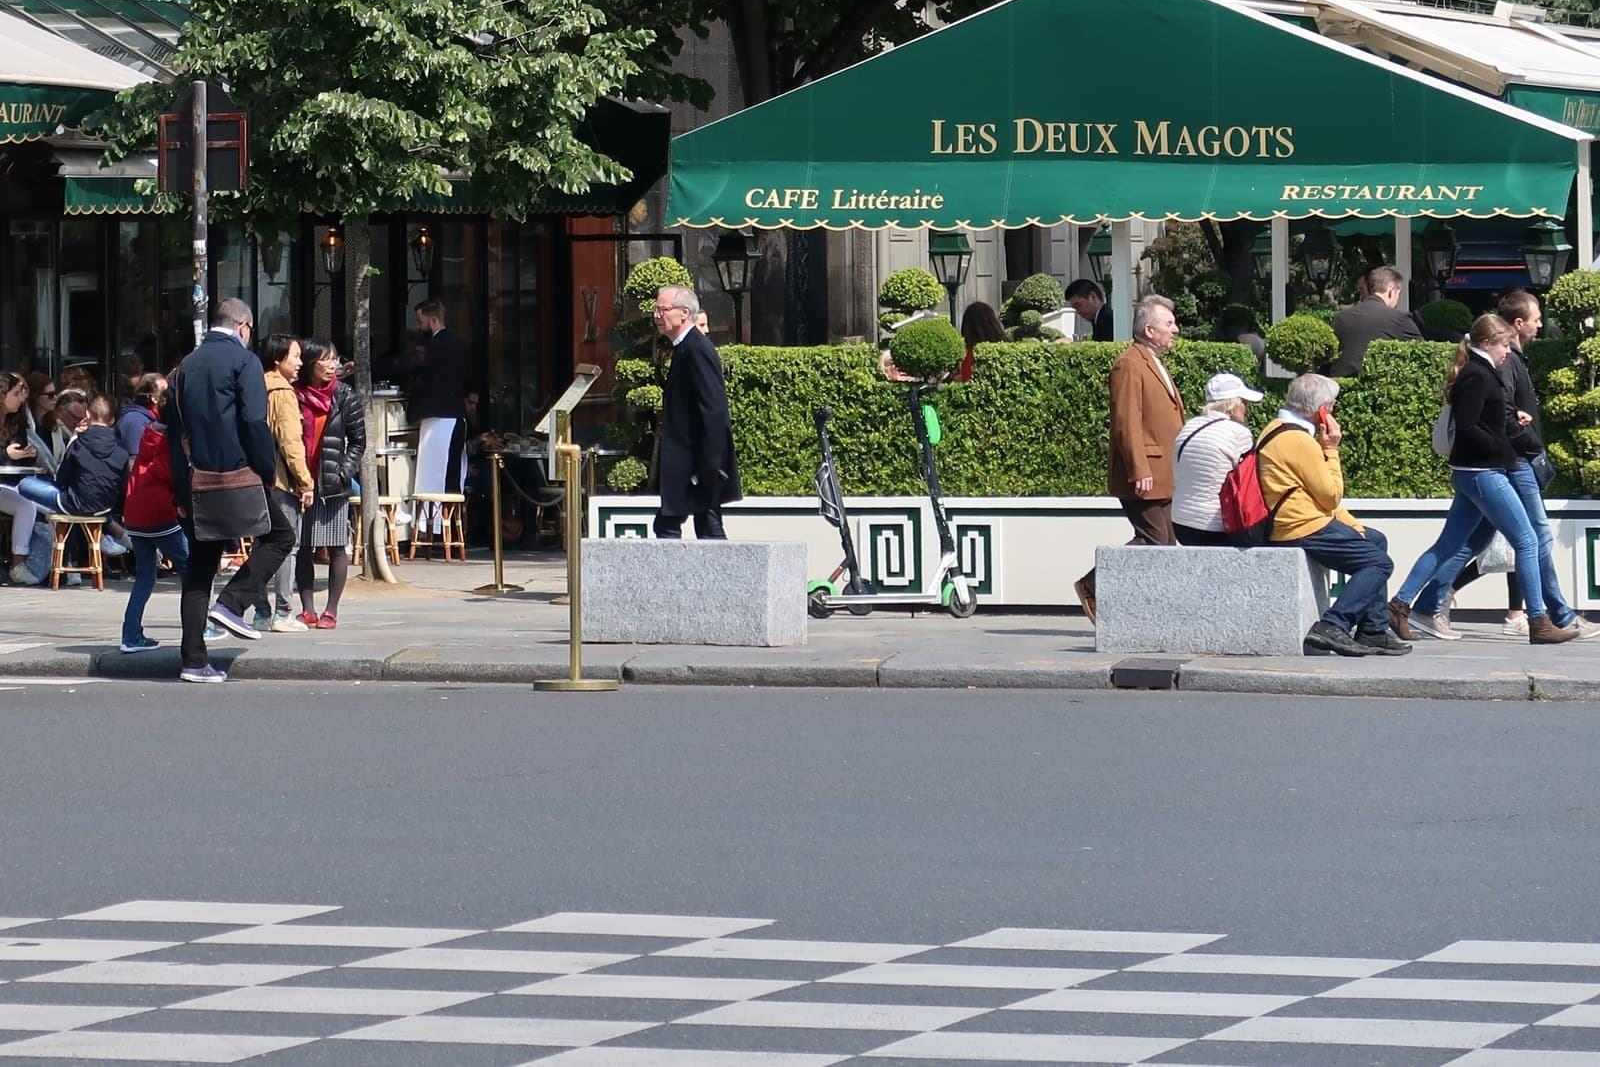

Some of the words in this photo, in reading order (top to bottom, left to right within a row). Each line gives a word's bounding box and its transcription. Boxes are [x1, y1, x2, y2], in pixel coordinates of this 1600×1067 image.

[930, 119, 998, 155] LES
[1012, 117, 1118, 155] DEUX
[1133, 119, 1294, 159] MAGOTS
[744, 188, 819, 210] CAFE
[831, 188, 944, 211] Littéraire
[1279, 184, 1483, 201] RESTAURANT
